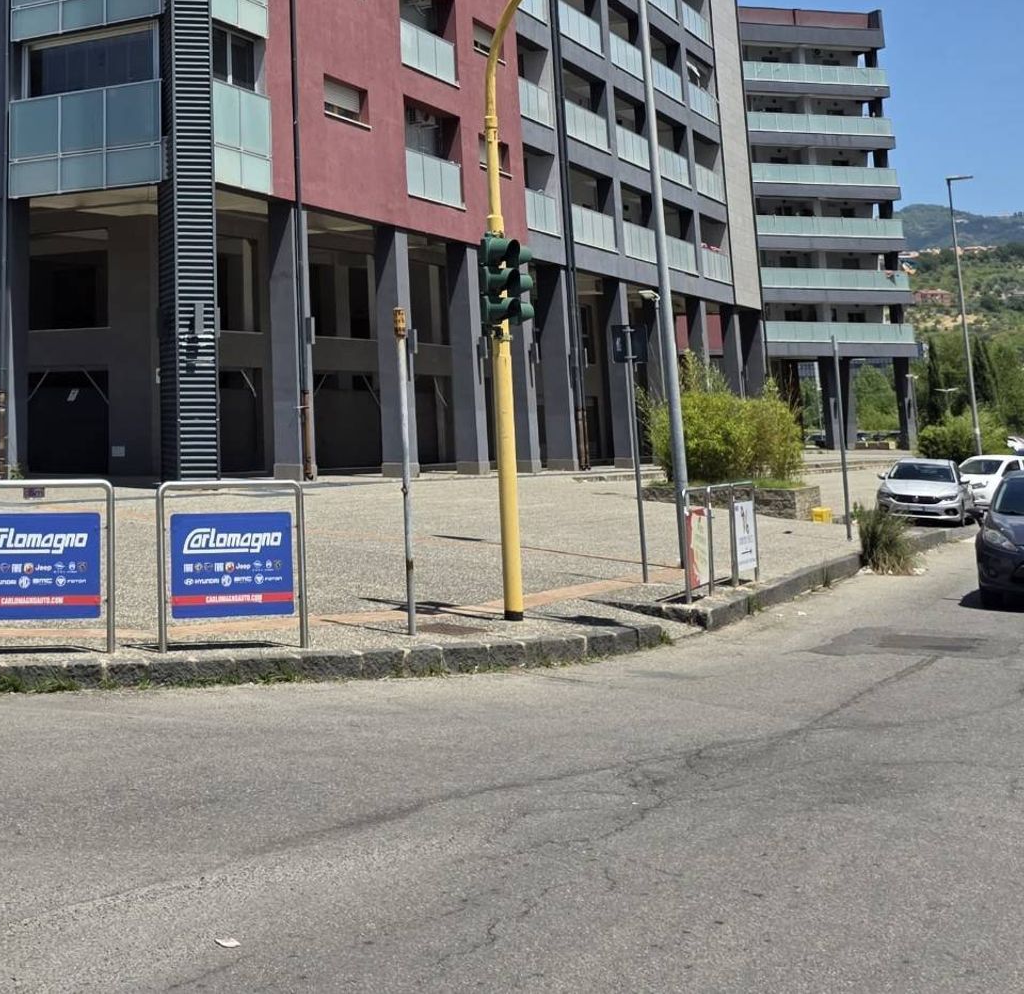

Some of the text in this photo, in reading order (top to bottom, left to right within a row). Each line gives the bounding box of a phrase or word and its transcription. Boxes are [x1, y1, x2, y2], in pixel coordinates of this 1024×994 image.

[182, 527, 282, 554] Carlomagno
[35, 563, 53, 572] Jeep
[236, 562, 251, 570] Jeep
